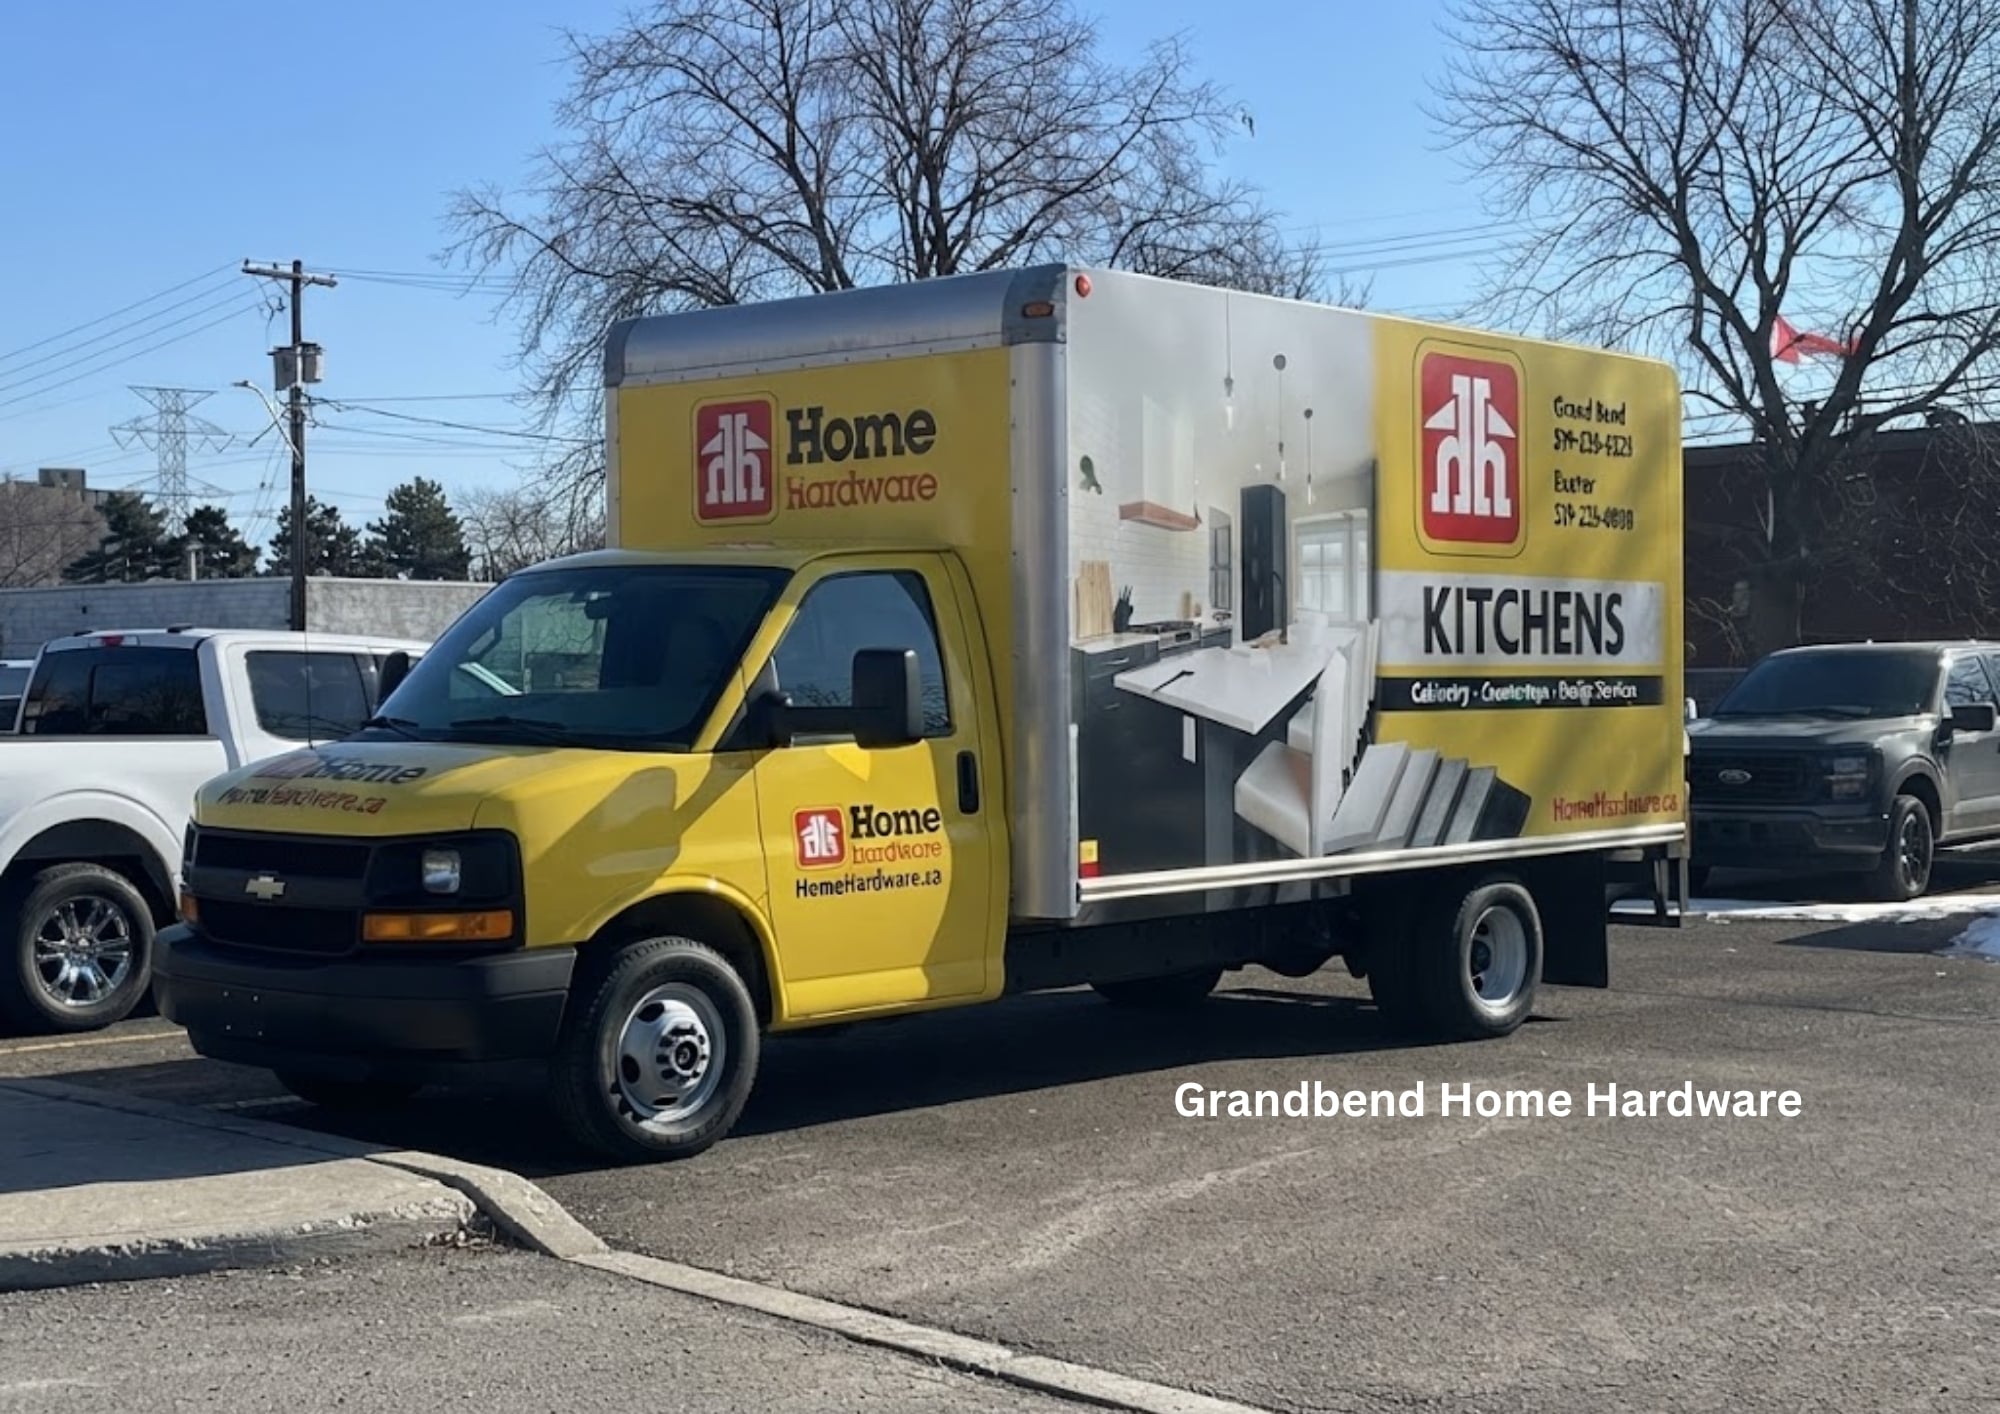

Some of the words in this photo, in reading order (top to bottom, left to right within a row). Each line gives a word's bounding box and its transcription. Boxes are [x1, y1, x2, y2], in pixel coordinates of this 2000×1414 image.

[786, 405, 937, 465] Home
[785, 470, 938, 511] hardware
[1423, 585, 1625, 656] KITCHENS
[850, 804, 941, 839] Home
